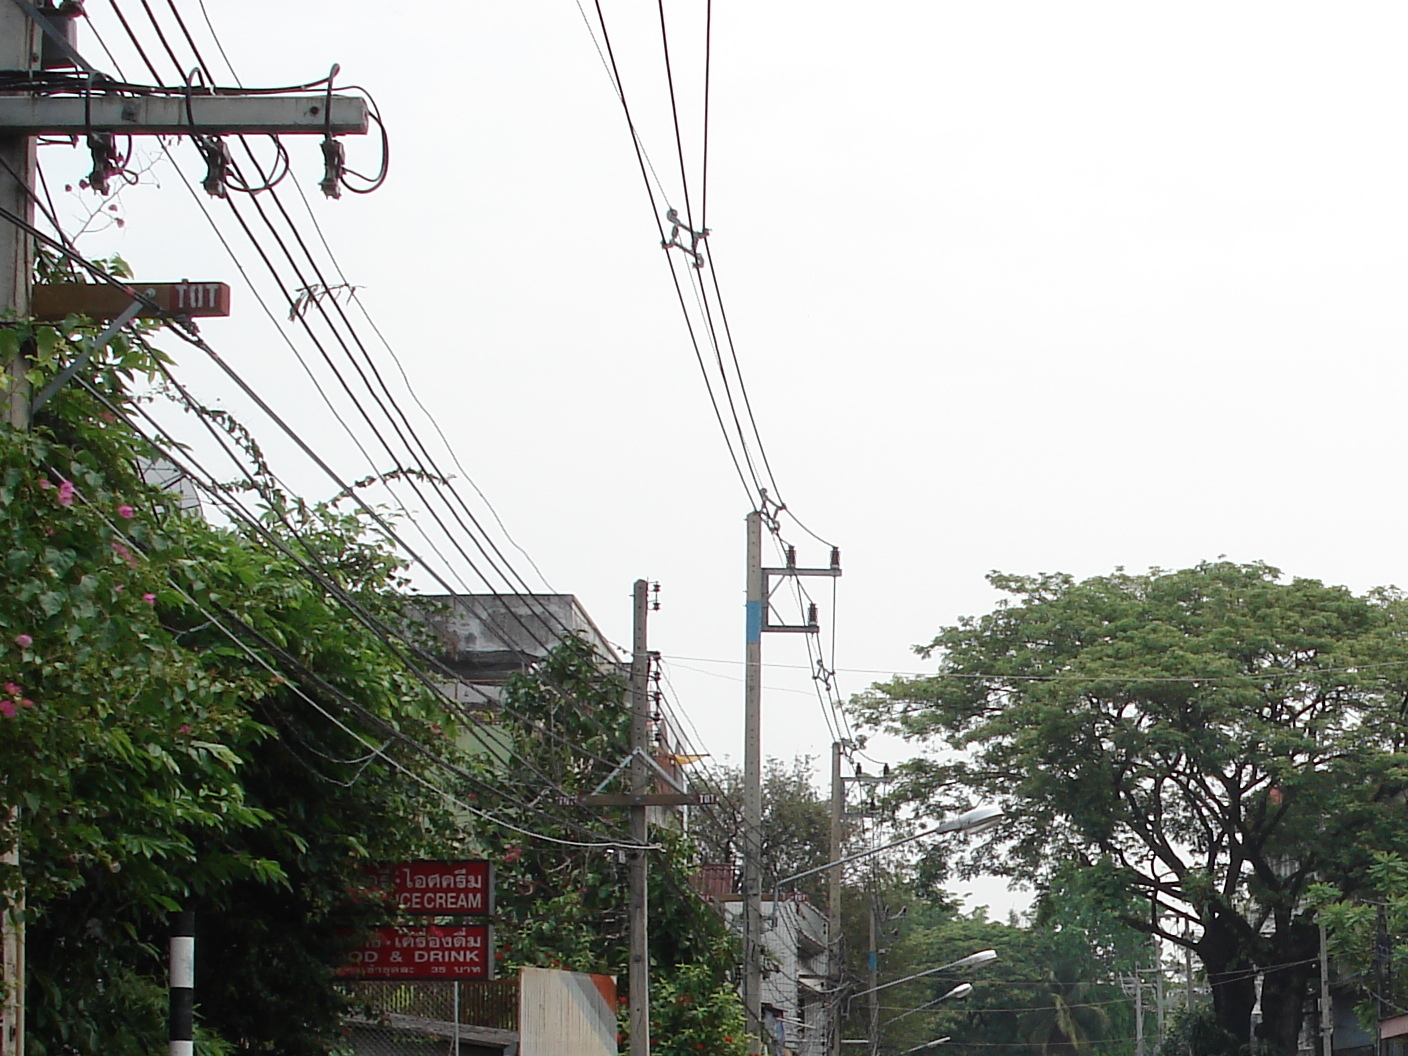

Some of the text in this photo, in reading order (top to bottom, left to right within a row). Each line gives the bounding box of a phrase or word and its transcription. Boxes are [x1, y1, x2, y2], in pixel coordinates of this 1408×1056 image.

[403, 868, 482, 889] ไอศครีม
[424, 893, 482, 909] CREAM
[390, 951, 403, 962] &
[414, 951, 480, 963] DRINK
[431, 966, 446, 974] 35
[454, 965, 481, 974] บาท
